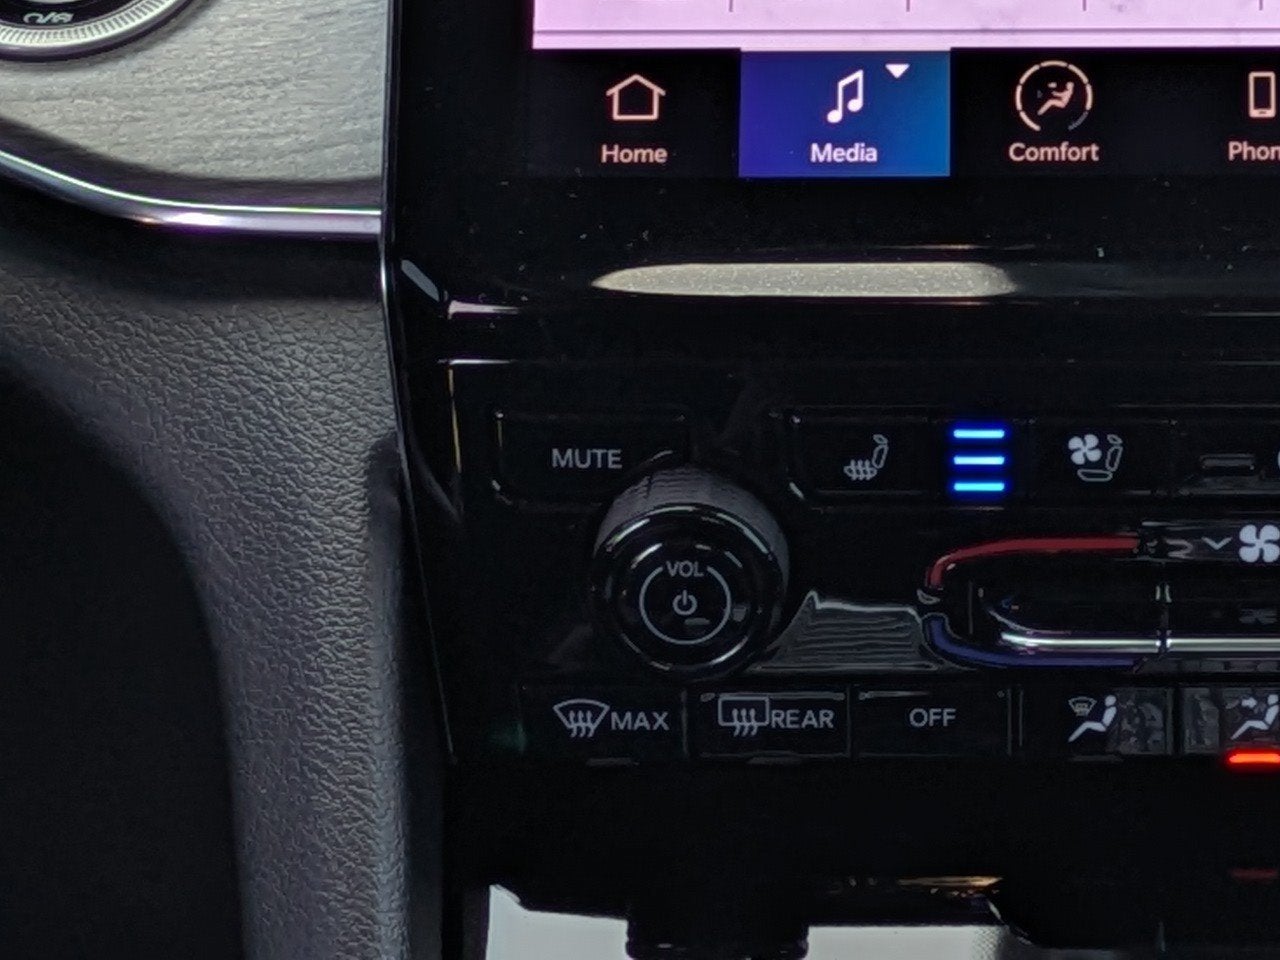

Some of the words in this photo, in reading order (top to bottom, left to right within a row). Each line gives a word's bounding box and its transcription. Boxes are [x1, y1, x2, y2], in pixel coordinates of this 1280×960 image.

[601, 144, 668, 164] Home
[810, 142, 878, 164] Media
[1008, 142, 1100, 162] Comfort
[551, 448, 622, 469] MUTE
[666, 560, 704, 578] VOL
[610, 710, 670, 731] MAX
[771, 709, 834, 729] REAR
[909, 708, 957, 728] OFF
